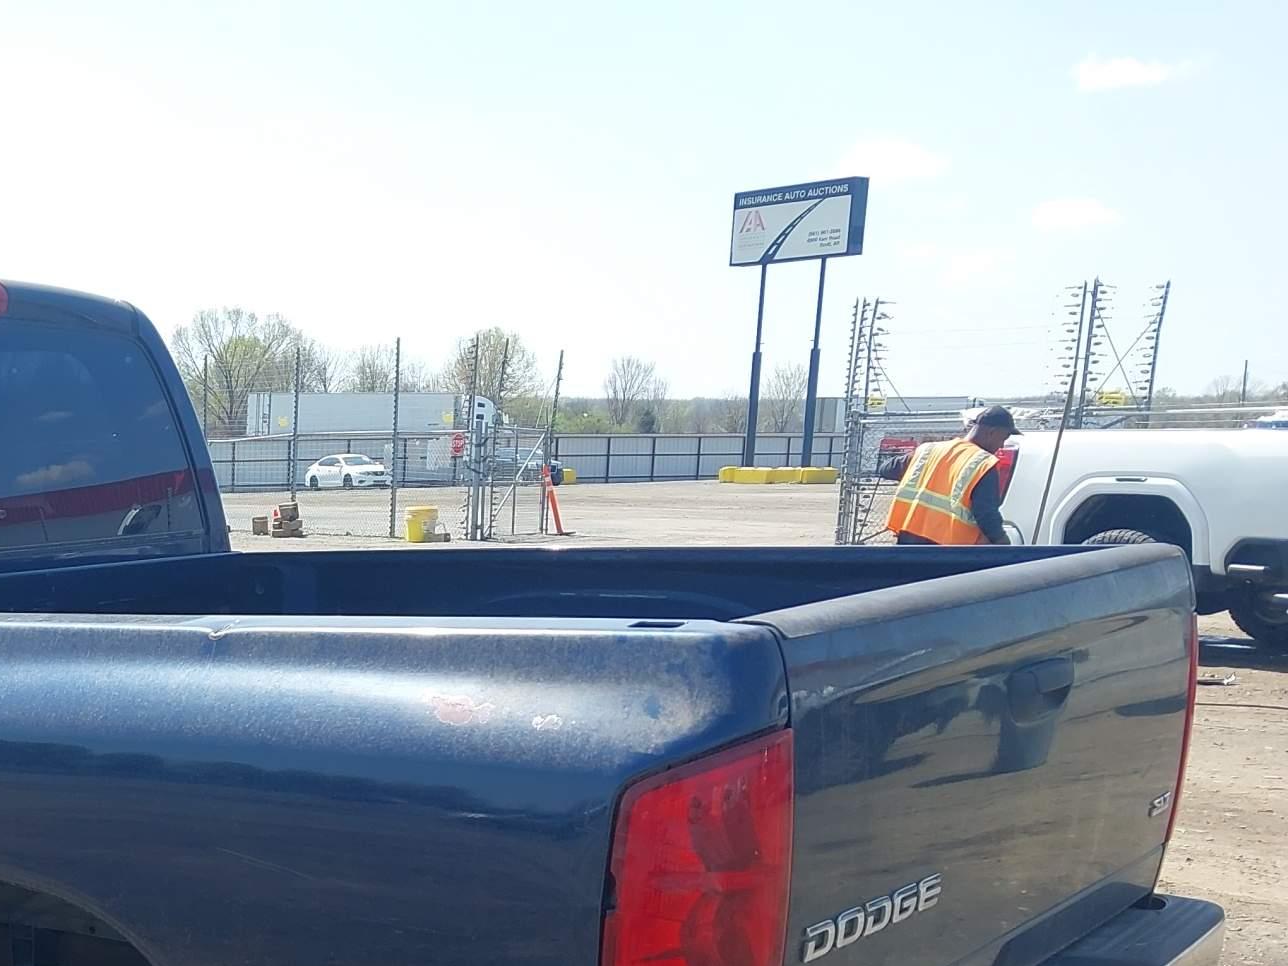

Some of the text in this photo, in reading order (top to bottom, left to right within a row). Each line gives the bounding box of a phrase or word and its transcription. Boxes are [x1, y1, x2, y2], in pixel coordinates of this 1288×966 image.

[739, 183, 849, 206] INSURANCE AUTO AUCTIONS
[451, 439, 464, 448] STOP
[802, 872, 943, 964] DODGE
